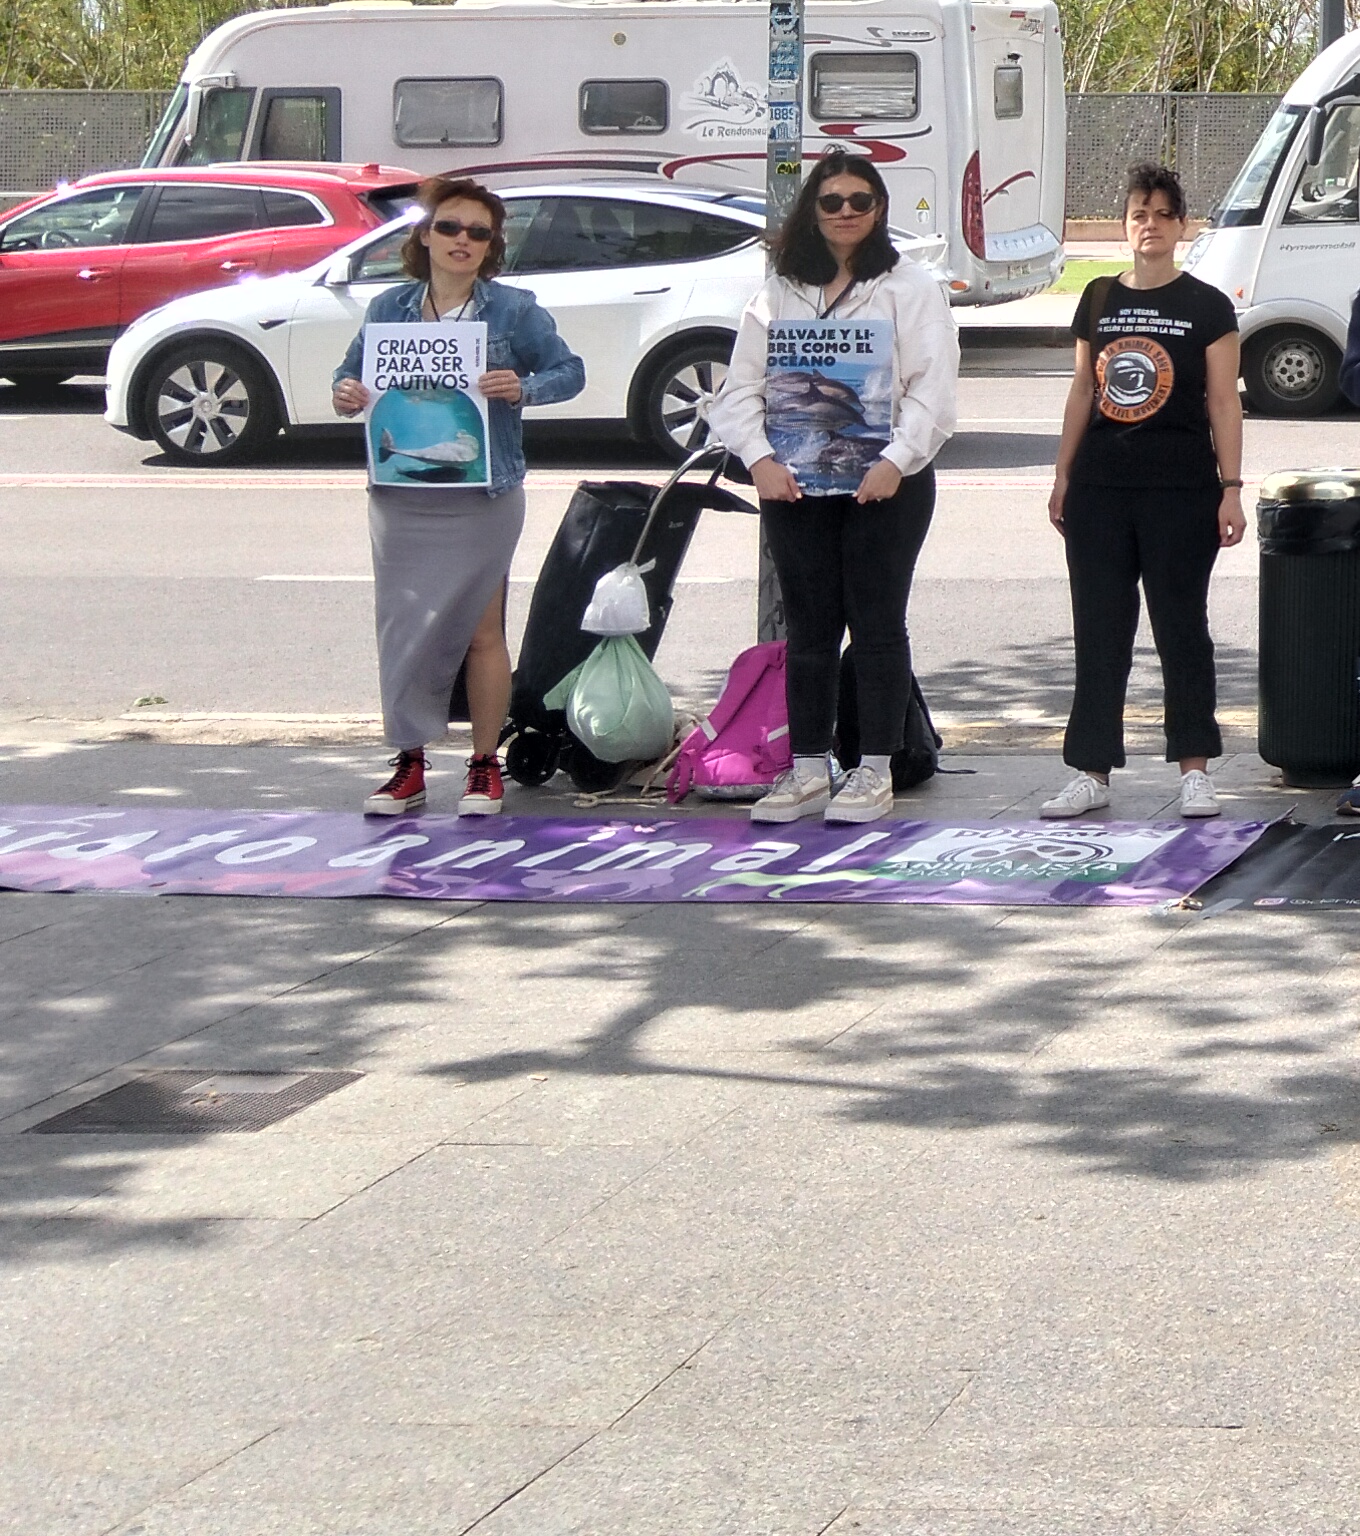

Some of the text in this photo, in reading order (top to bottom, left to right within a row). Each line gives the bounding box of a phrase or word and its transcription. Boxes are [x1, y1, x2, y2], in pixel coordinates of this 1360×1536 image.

[702, 126, 714, 137] Le
[767, 328, 836, 340] SALVAJE
[839, 329, 851, 340] Y
[1159, 326, 1168, 334] LA
[377, 338, 459, 355] CRIADOS
[767, 342, 873, 354] BRE COMO EL
[376, 356, 463, 372] PARA SER
[374, 373, 469, 390] CAUTIVOS
[326, 830, 891, 873] animal
[882, 860, 1118, 872] ANIMALISTA
